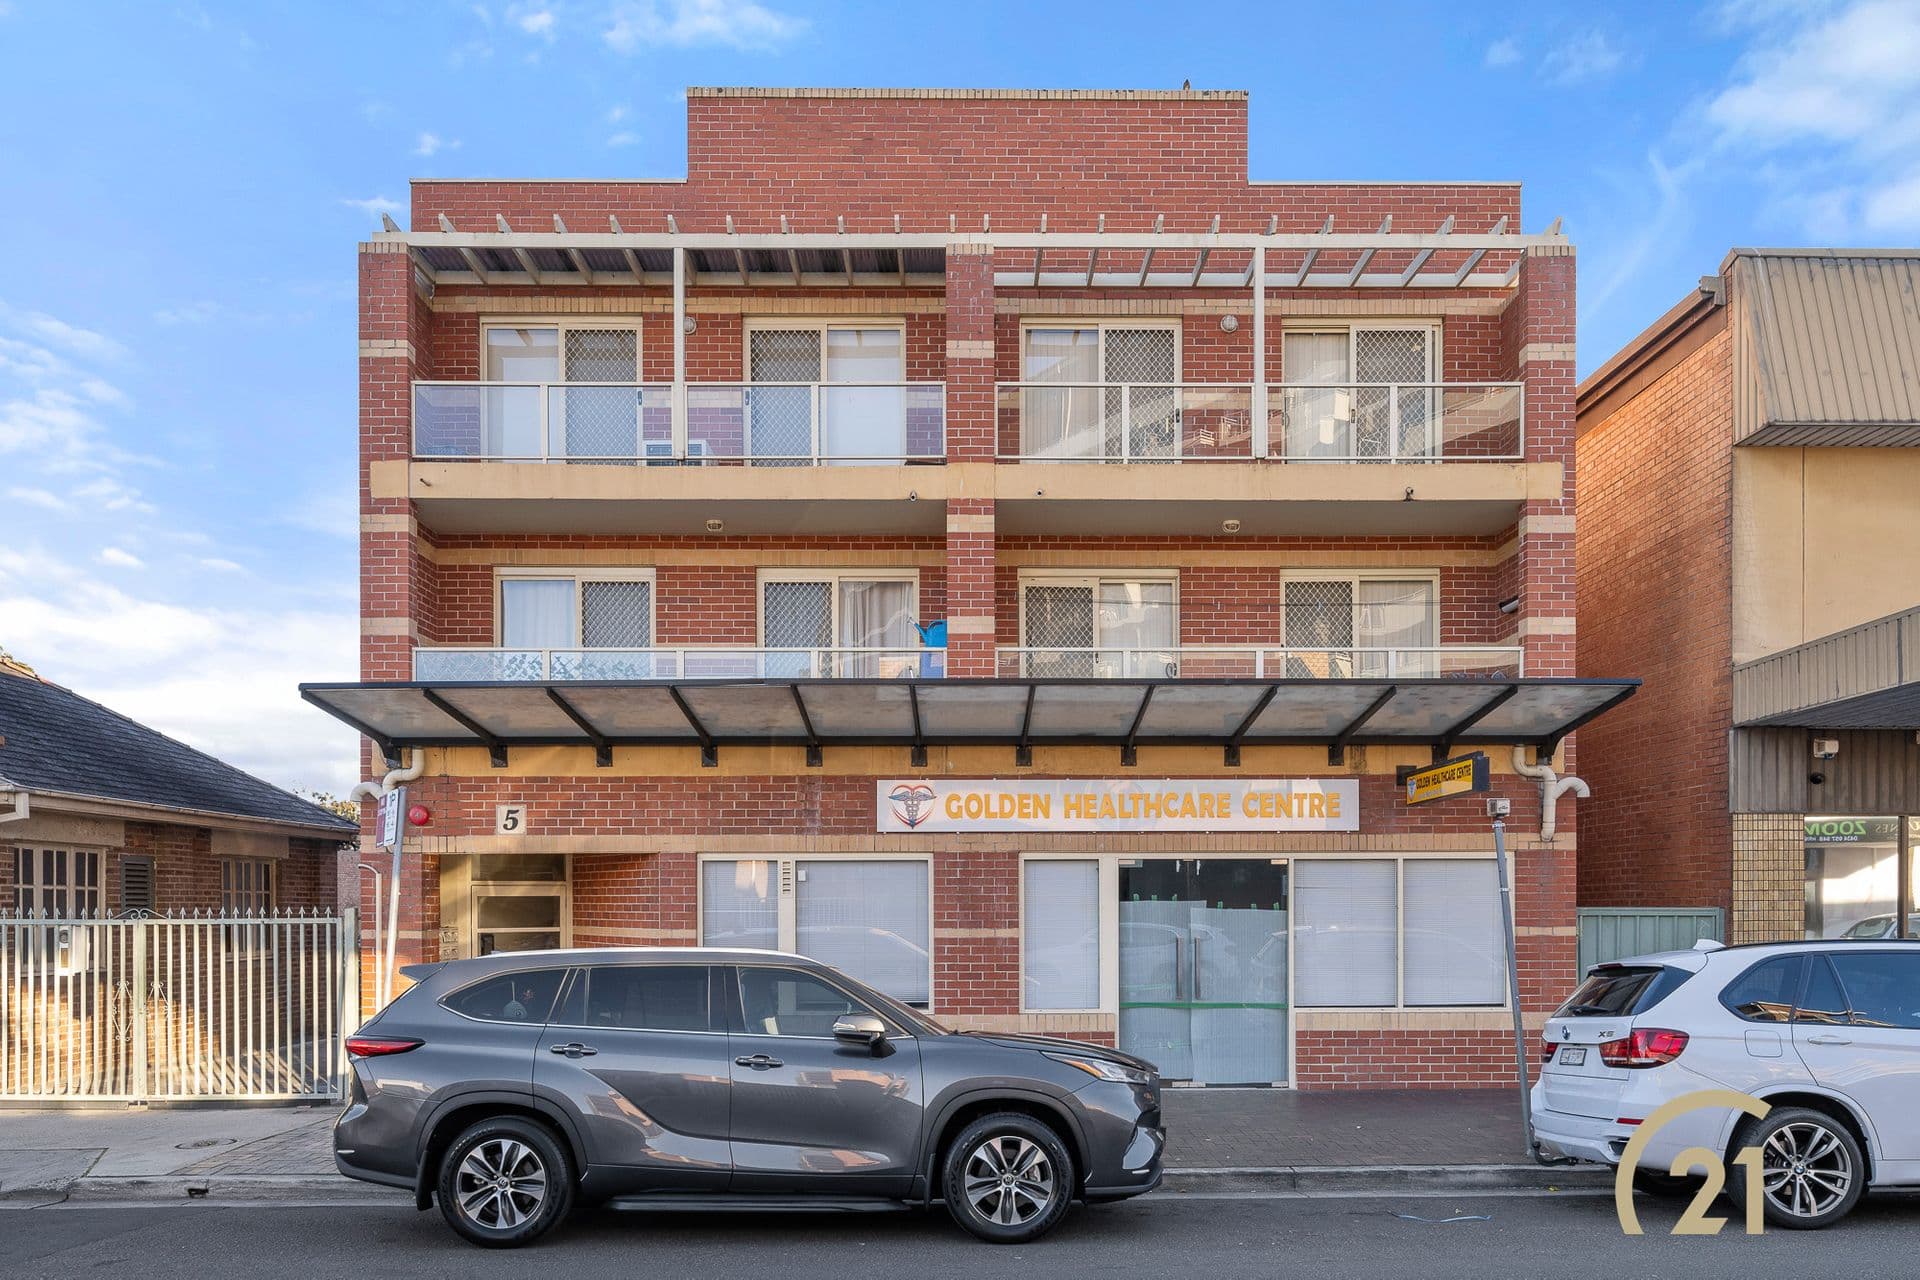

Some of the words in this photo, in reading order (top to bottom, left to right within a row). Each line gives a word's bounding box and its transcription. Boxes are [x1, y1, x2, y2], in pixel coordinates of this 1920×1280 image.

[944, 792, 1051, 819] GOLDEN
[1063, 791, 1231, 819] HEALTHCARE
[1242, 791, 1341, 819] CENTRE
[503, 809, 520, 831] 5
